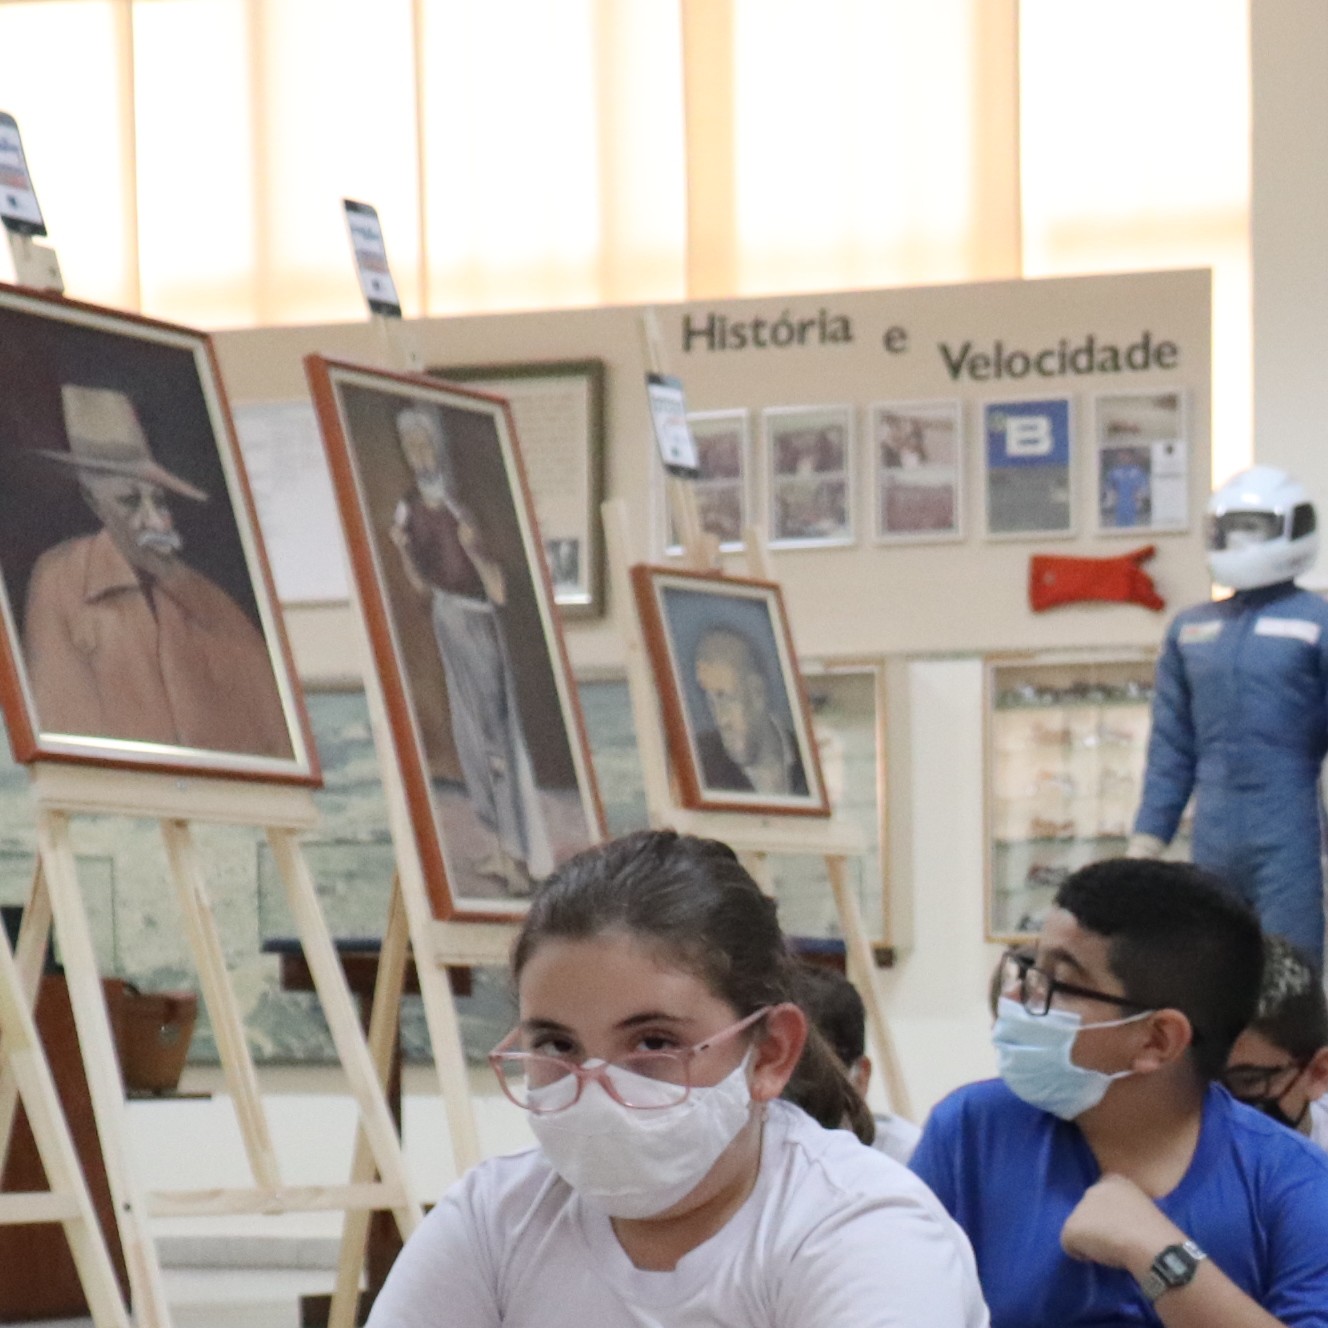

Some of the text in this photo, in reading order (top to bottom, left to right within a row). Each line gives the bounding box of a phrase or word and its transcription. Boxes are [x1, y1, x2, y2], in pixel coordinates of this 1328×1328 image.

[681, 308, 1179, 382] História e Velocidade
